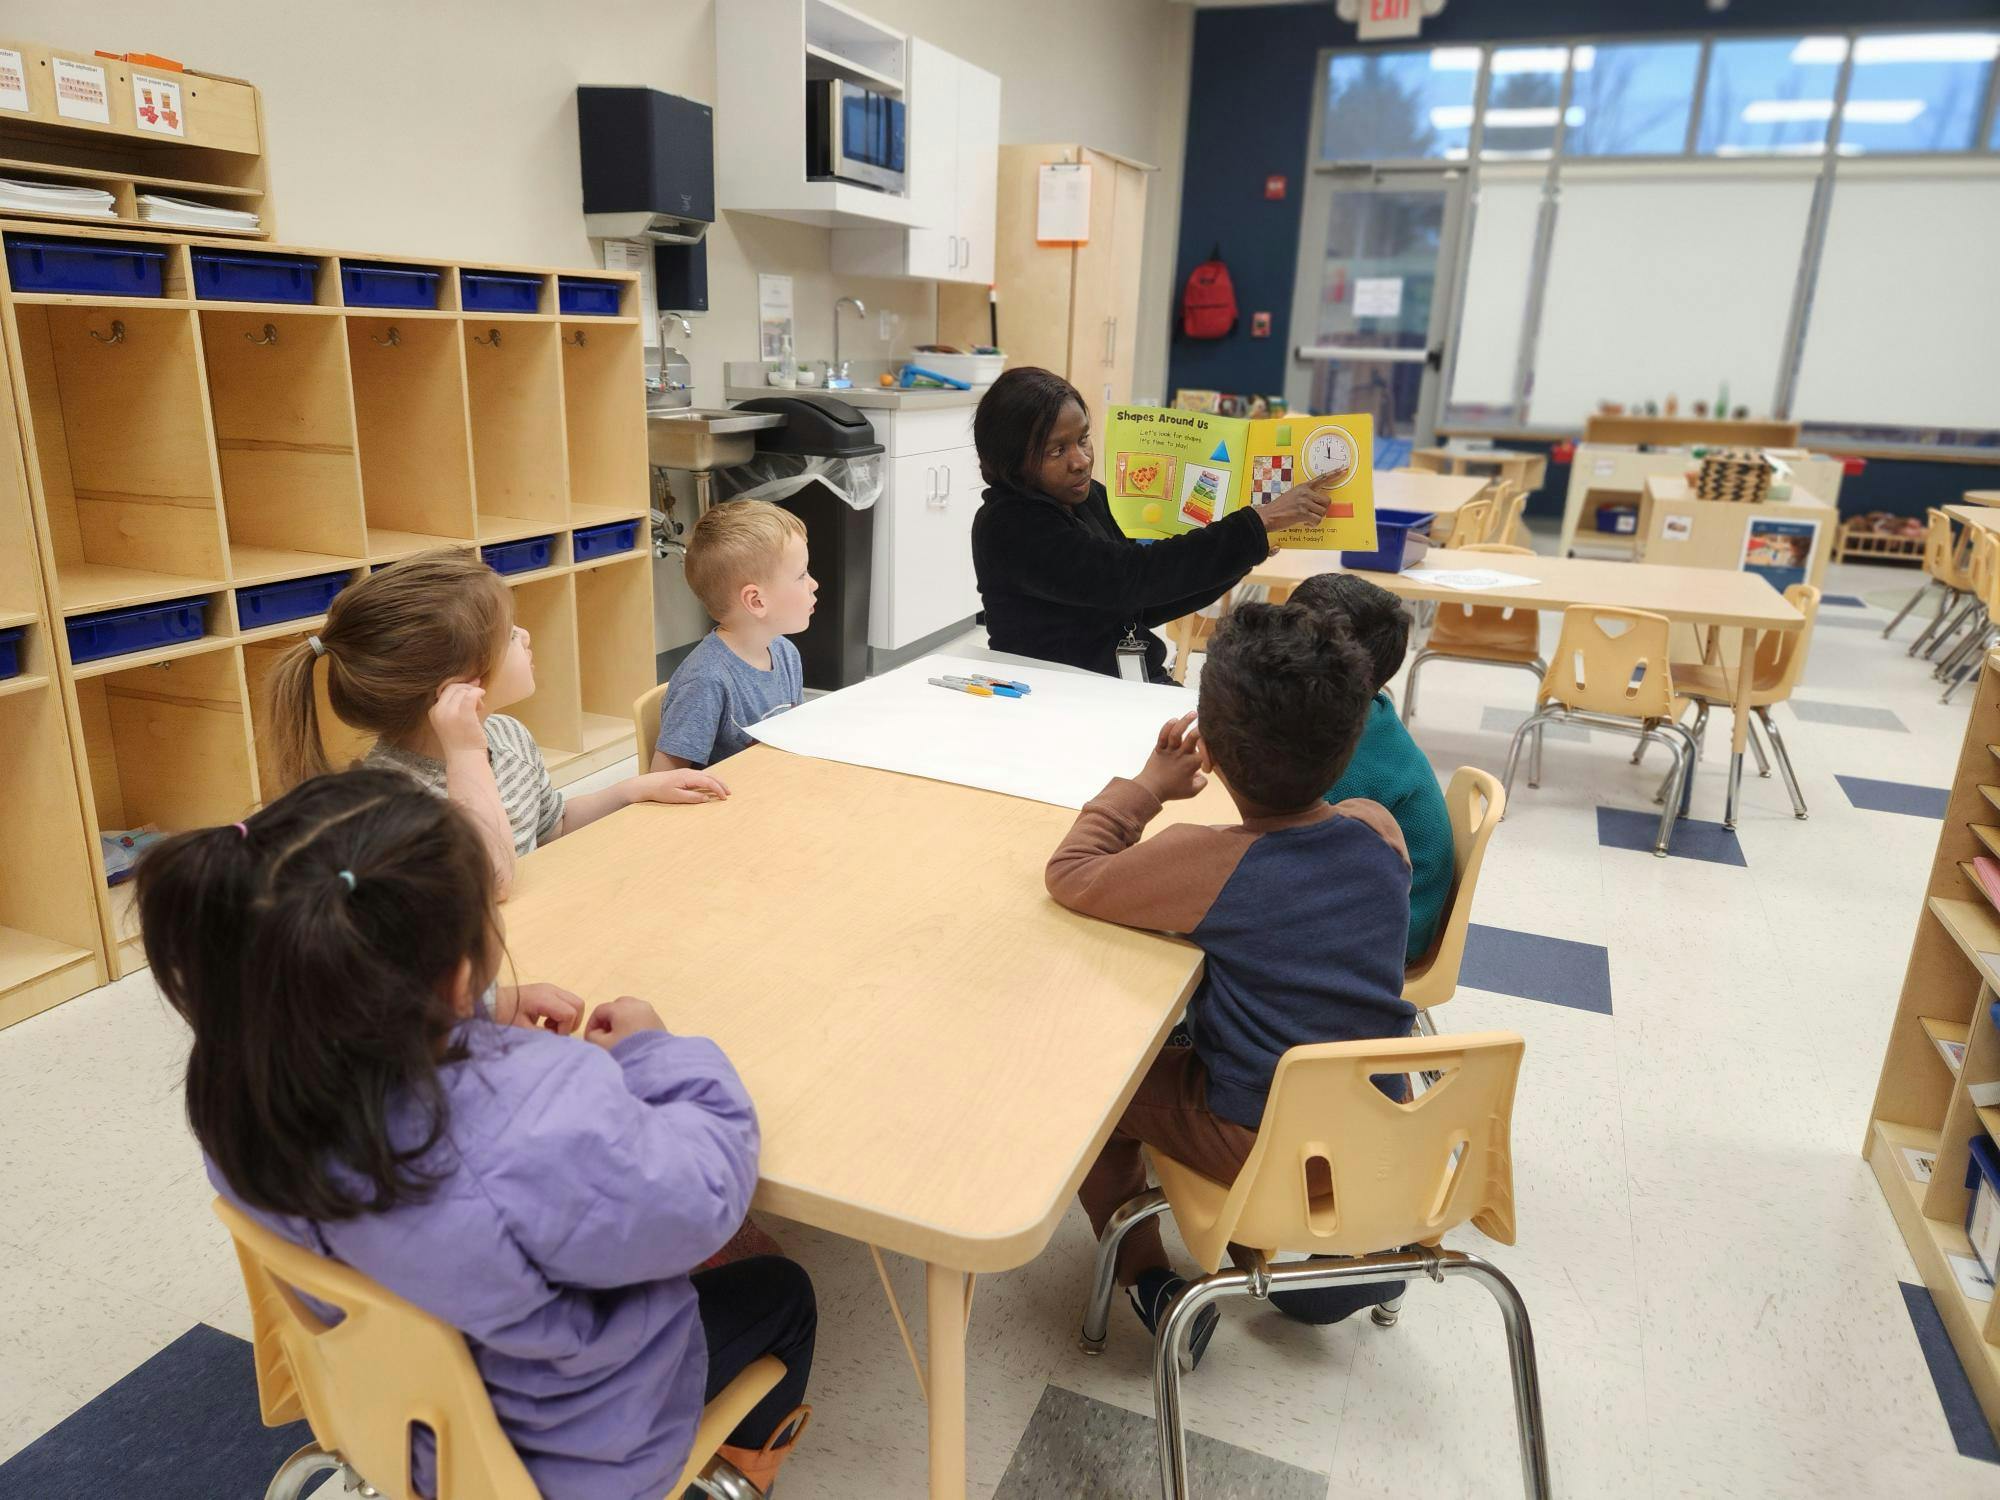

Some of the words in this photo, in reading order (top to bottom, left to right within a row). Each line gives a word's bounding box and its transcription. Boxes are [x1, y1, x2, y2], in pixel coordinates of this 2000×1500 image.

[1117, 410, 1154, 423] Shapes
[1158, 413, 1194, 428] Around
[1197, 419, 1209, 430] Us
[1173, 432, 1183, 440] for
